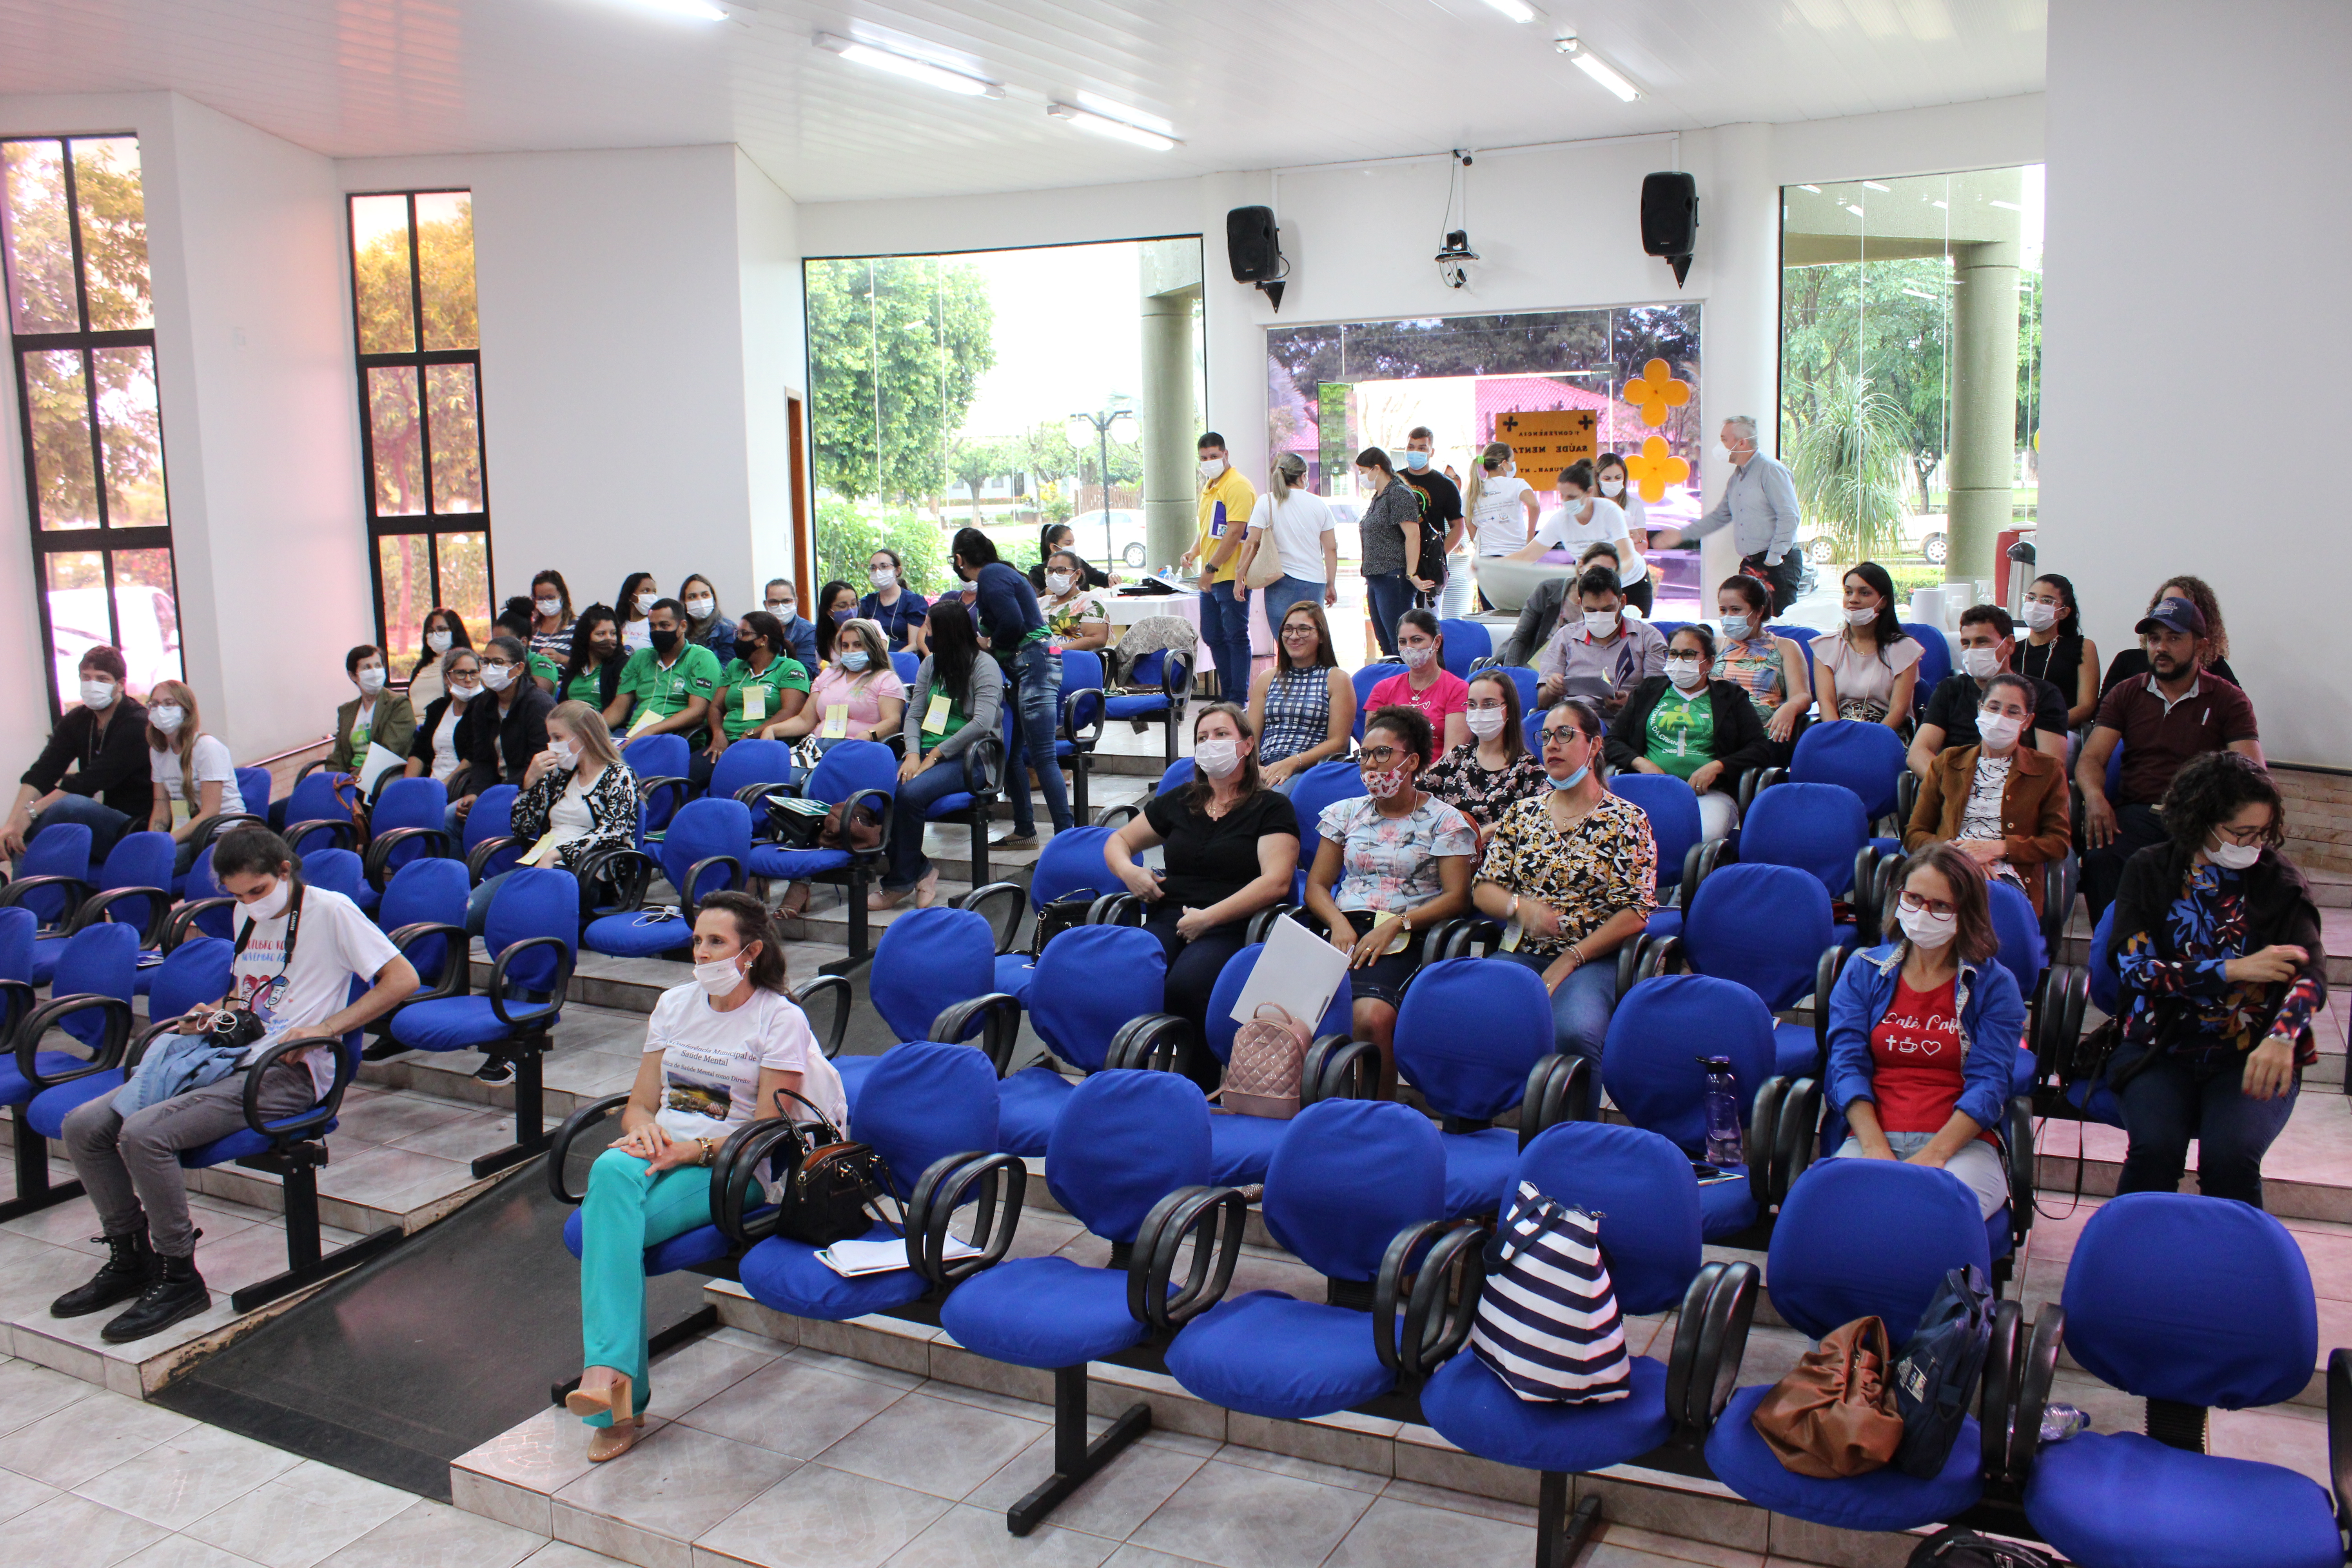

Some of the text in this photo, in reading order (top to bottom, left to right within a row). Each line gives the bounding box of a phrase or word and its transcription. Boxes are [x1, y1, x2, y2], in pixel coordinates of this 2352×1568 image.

[1651, 726, 1660, 736] DA
[289, 911, 298, 931] Canon
[672, 1041, 712, 1053] Conferência
[712, 1049, 748, 1059] Municipal
[681, 1050, 729, 1066] Saúde Mental
[697, 1068, 715, 1077] Mental
[731, 1076, 751, 1084] Direito:
